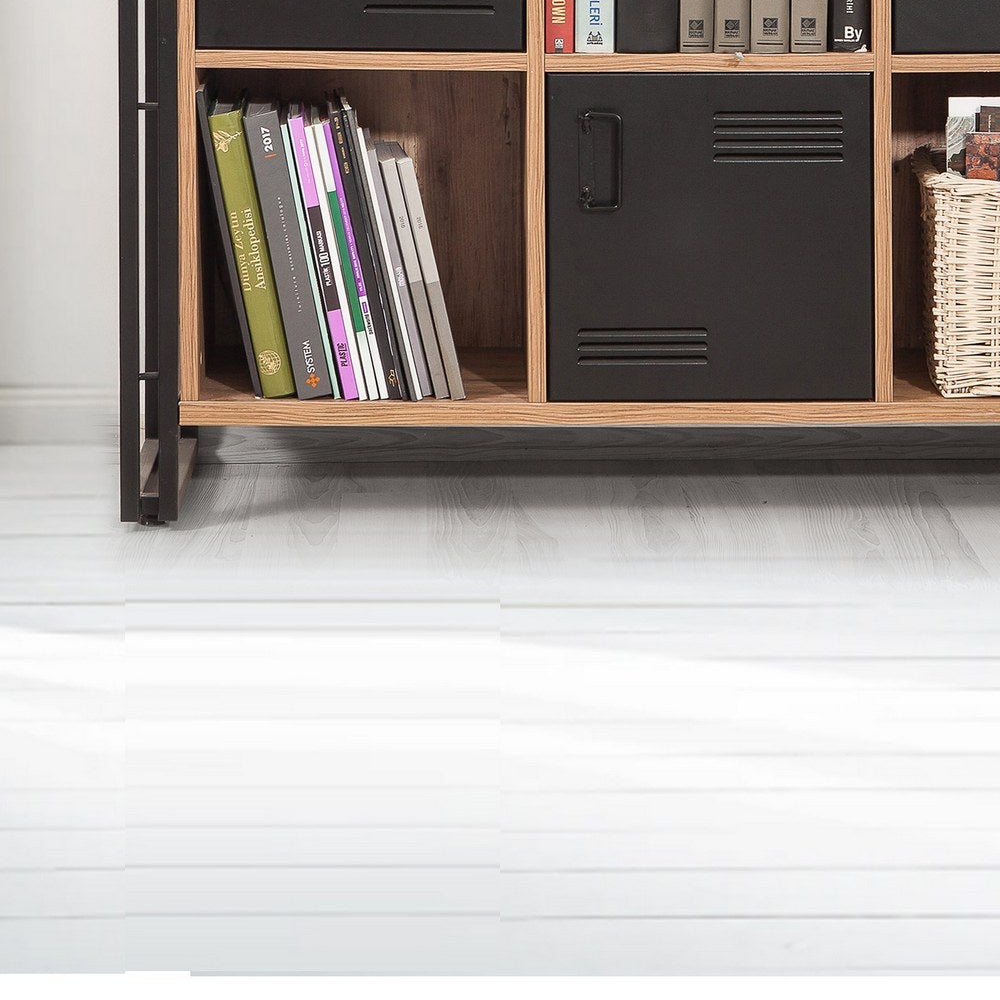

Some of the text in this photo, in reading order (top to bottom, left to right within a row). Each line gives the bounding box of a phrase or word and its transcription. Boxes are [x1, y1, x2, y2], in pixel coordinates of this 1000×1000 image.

[844, 26, 862, 42] By
[261, 127, 273, 152] 2017
[241, 208, 266, 289] Ansiklopedisi
[318, 252, 330, 267] 100
[303, 340, 315, 373] SYSTEM
